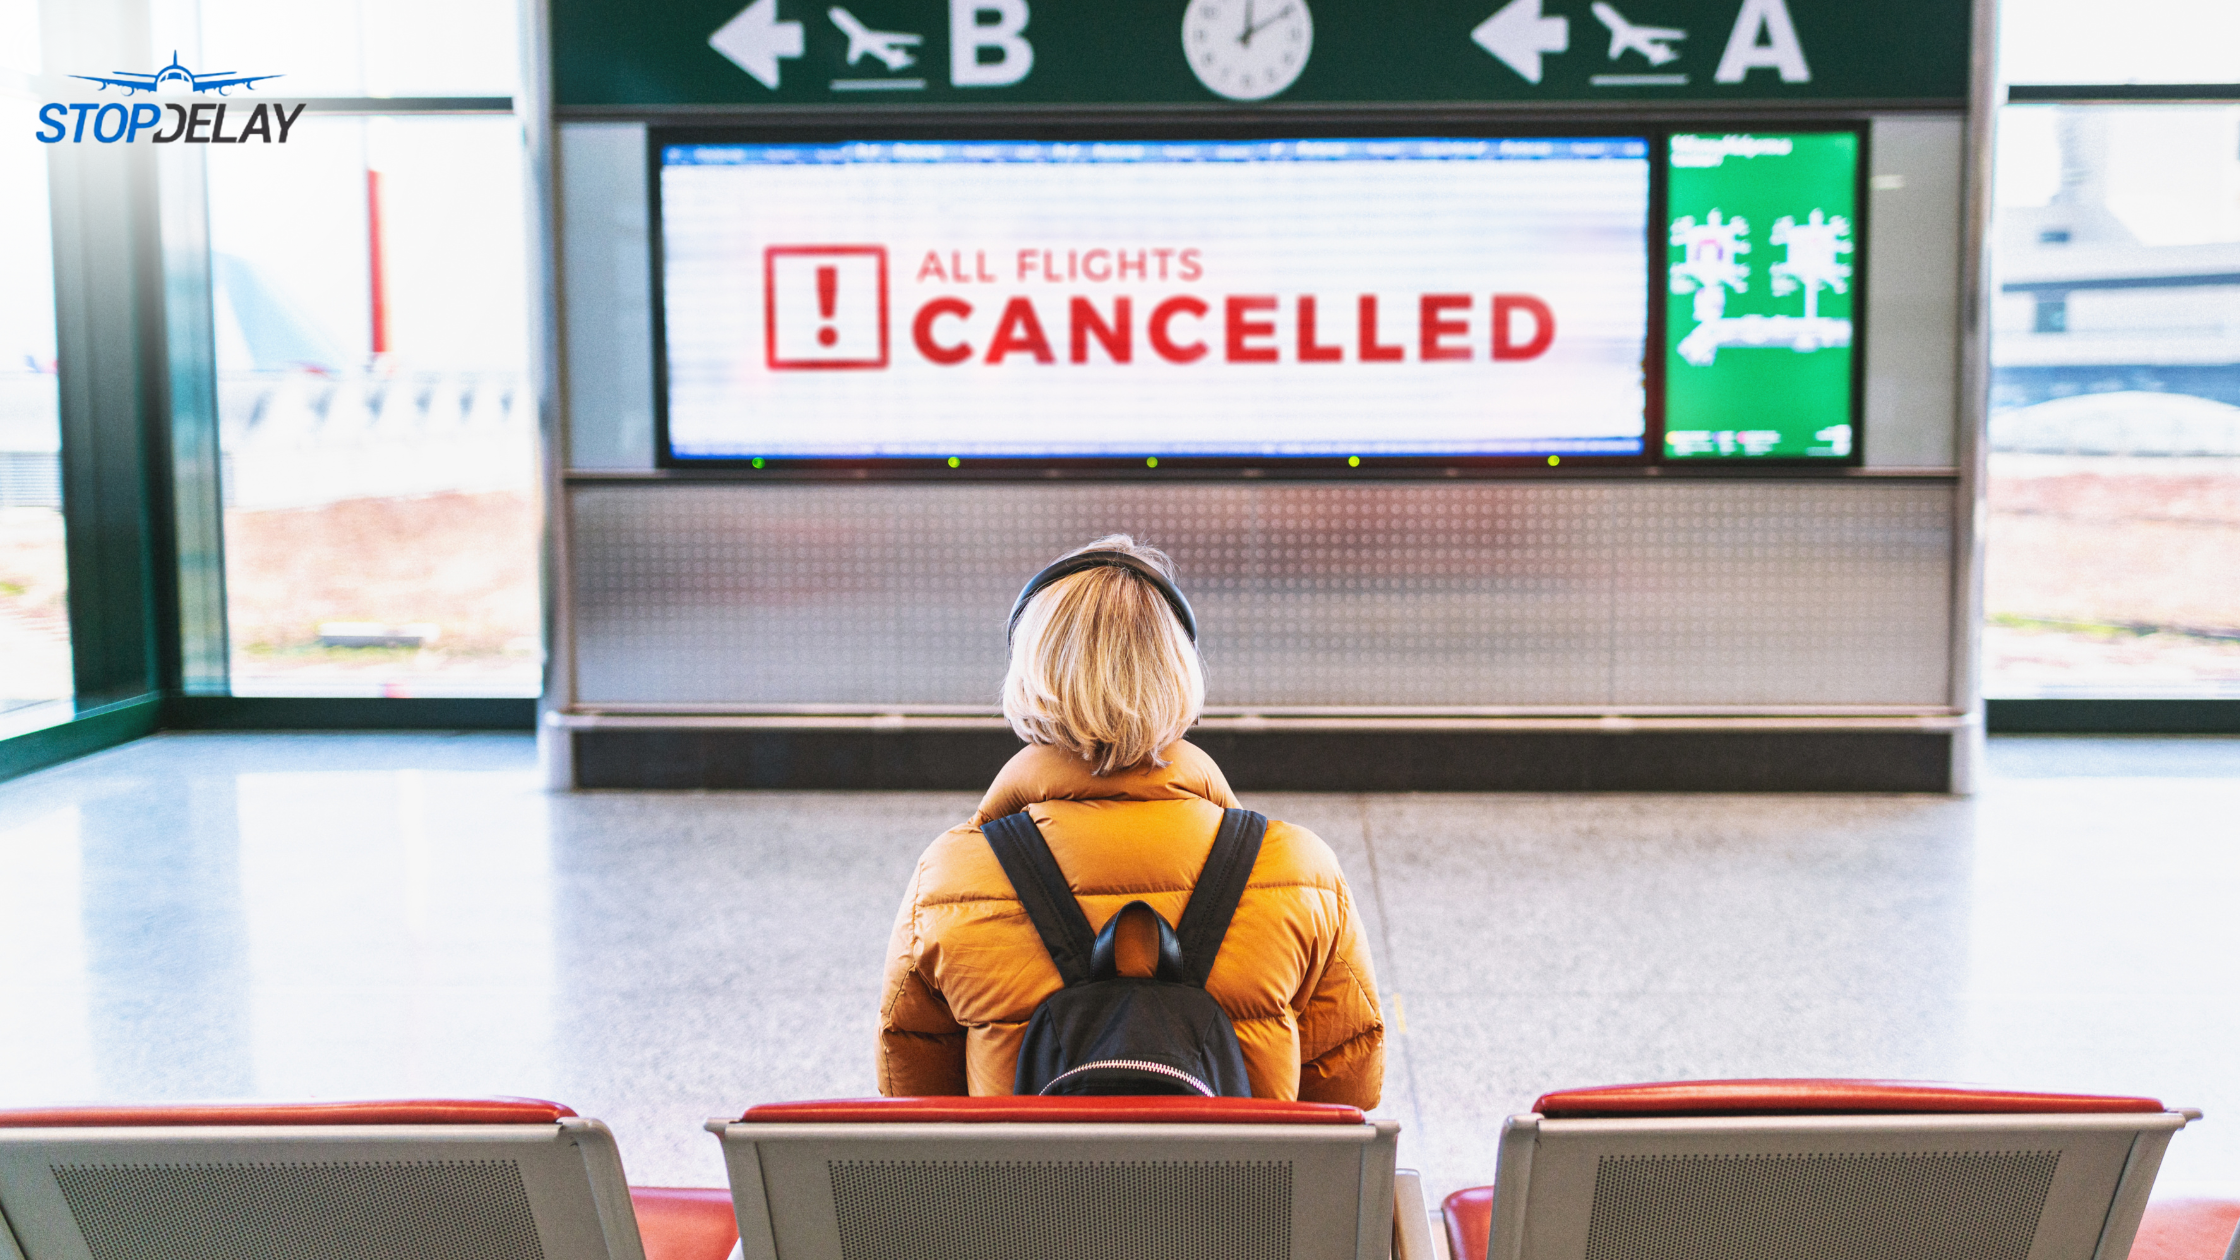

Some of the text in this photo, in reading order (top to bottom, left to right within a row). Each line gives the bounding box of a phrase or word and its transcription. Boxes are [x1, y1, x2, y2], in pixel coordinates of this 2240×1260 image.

[950, 0, 1033, 86] B
[1715, 0, 1811, 82] A
[917, 248, 1204, 283] ALL FLIGHTS
[911, 294, 1557, 366] CANCELLED
